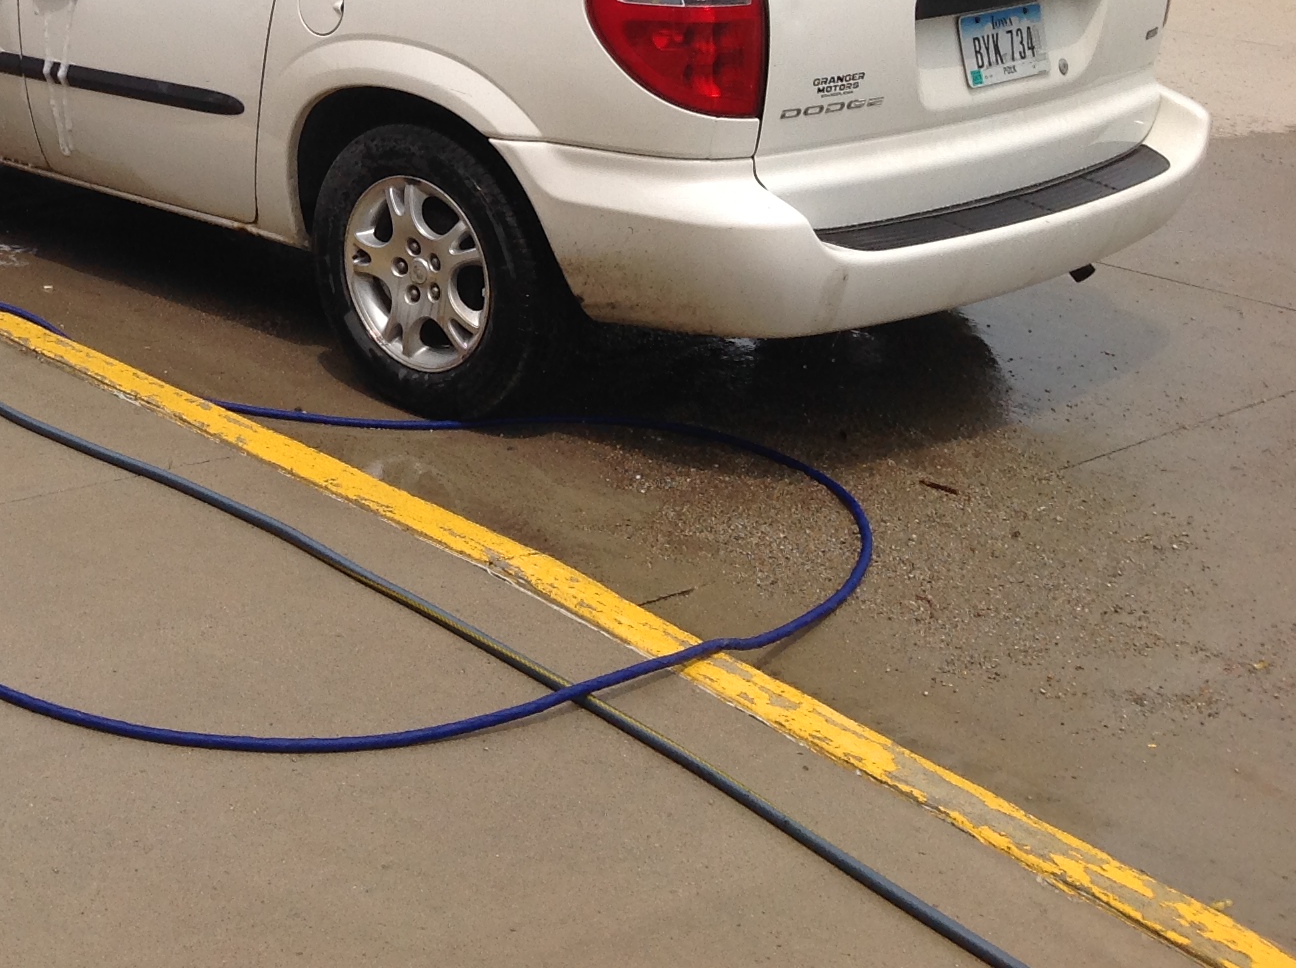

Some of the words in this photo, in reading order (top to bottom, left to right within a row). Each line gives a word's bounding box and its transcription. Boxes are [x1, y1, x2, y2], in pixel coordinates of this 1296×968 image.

[972, 32, 1004, 69] BYK
[1006, 26, 1036, 62] 734
[812, 71, 866, 87] GRANGER
[816, 81, 860, 94] MOTORS
[779, 96, 885, 119] DODGE
